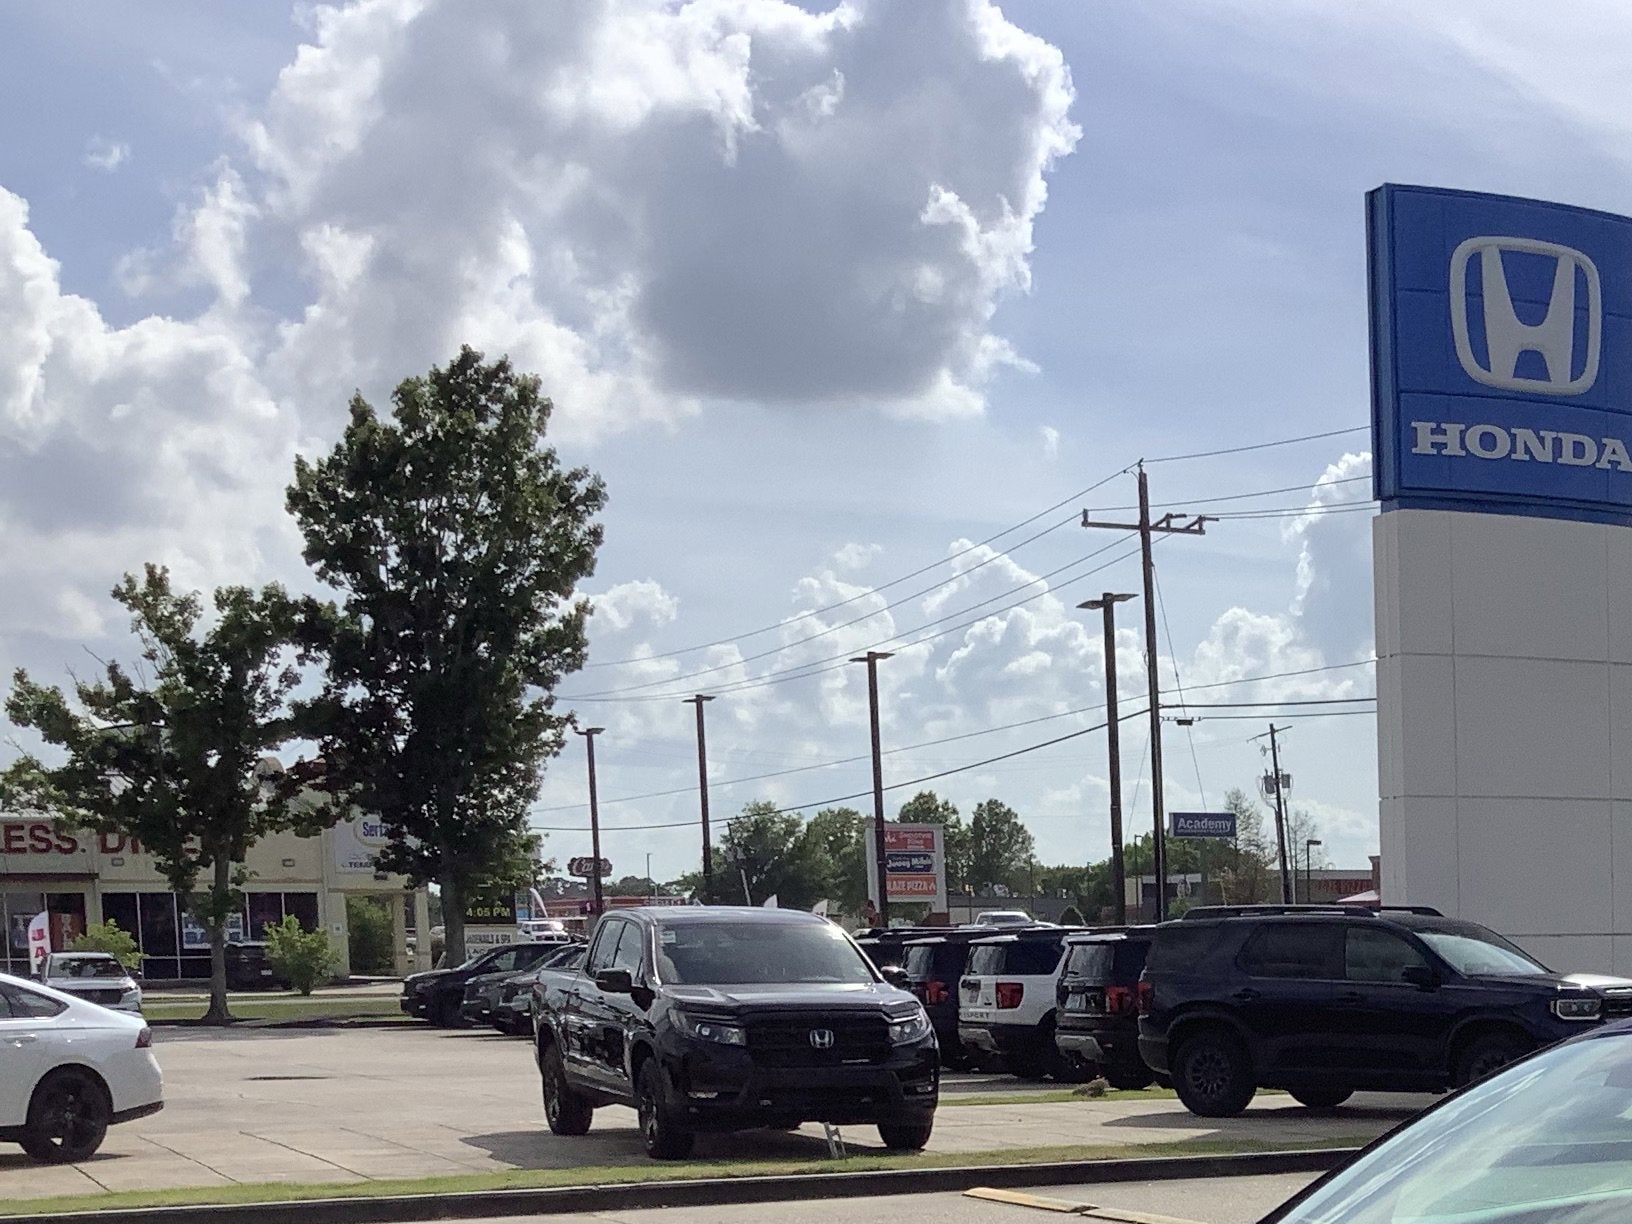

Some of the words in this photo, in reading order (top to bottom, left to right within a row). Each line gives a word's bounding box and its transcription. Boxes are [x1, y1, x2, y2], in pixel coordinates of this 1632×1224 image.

[1177, 817, 1232, 833] Academy
[466, 907, 491, 917] 4:05
[493, 907, 510, 917] PM
